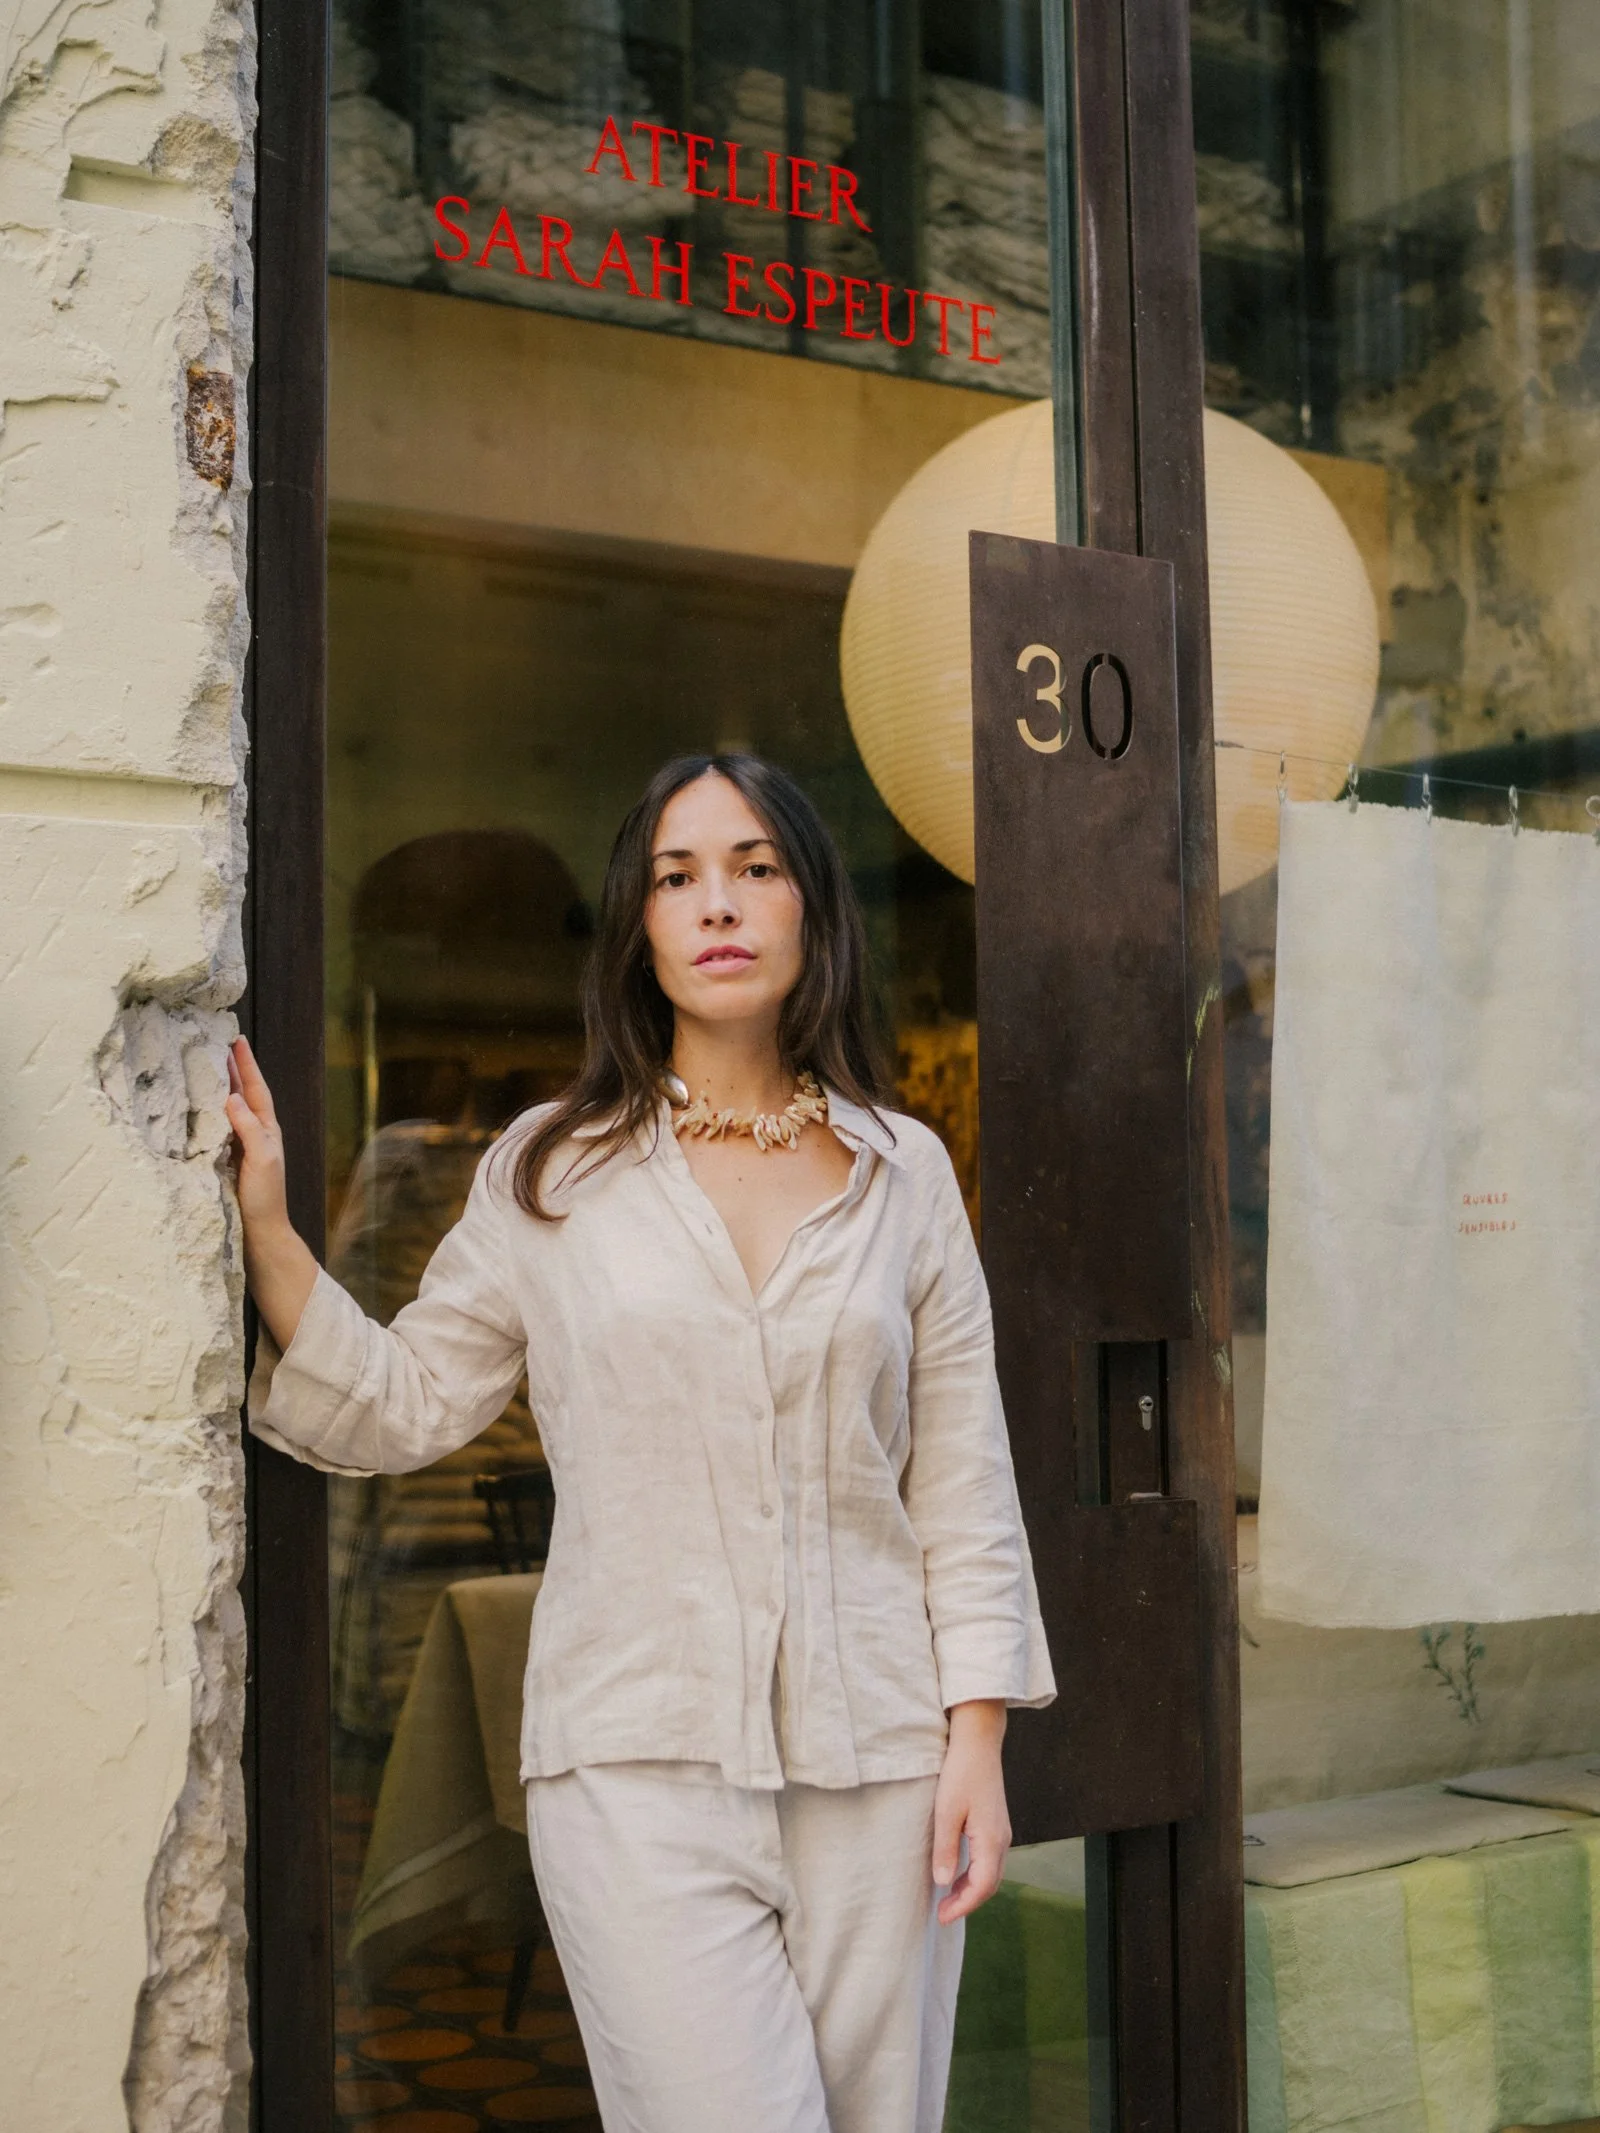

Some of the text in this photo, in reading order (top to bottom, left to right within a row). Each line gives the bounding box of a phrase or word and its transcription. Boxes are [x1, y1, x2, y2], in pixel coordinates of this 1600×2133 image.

[584, 115, 873, 233] ATELIER
[433, 195, 1002, 366] SARAH ESPEUTE
[1016, 643, 1134, 761] 30
